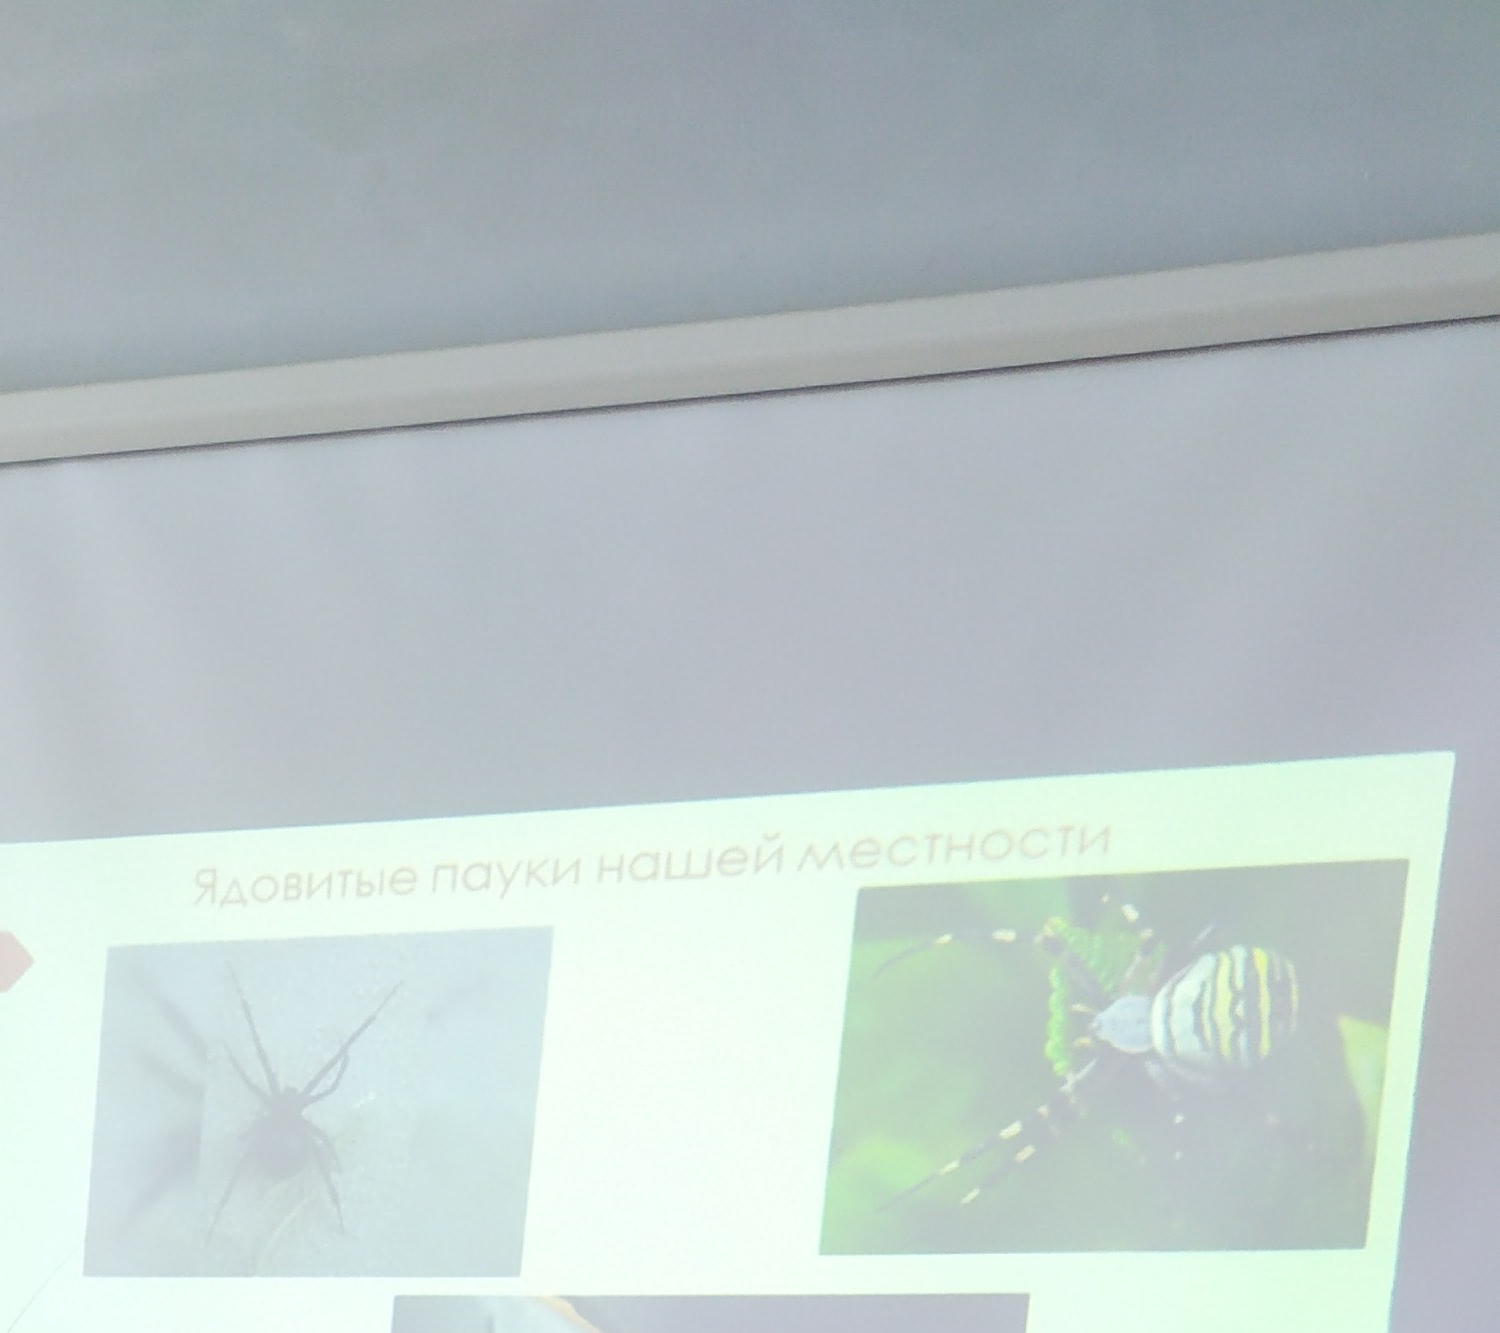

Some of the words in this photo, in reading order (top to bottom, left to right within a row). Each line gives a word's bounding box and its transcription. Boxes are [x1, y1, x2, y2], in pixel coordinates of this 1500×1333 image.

[193, 865, 419, 908] Ядовитые
[430, 856, 583, 900] пауки
[596, 831, 786, 884] нашей
[796, 824, 1114, 873] местности
